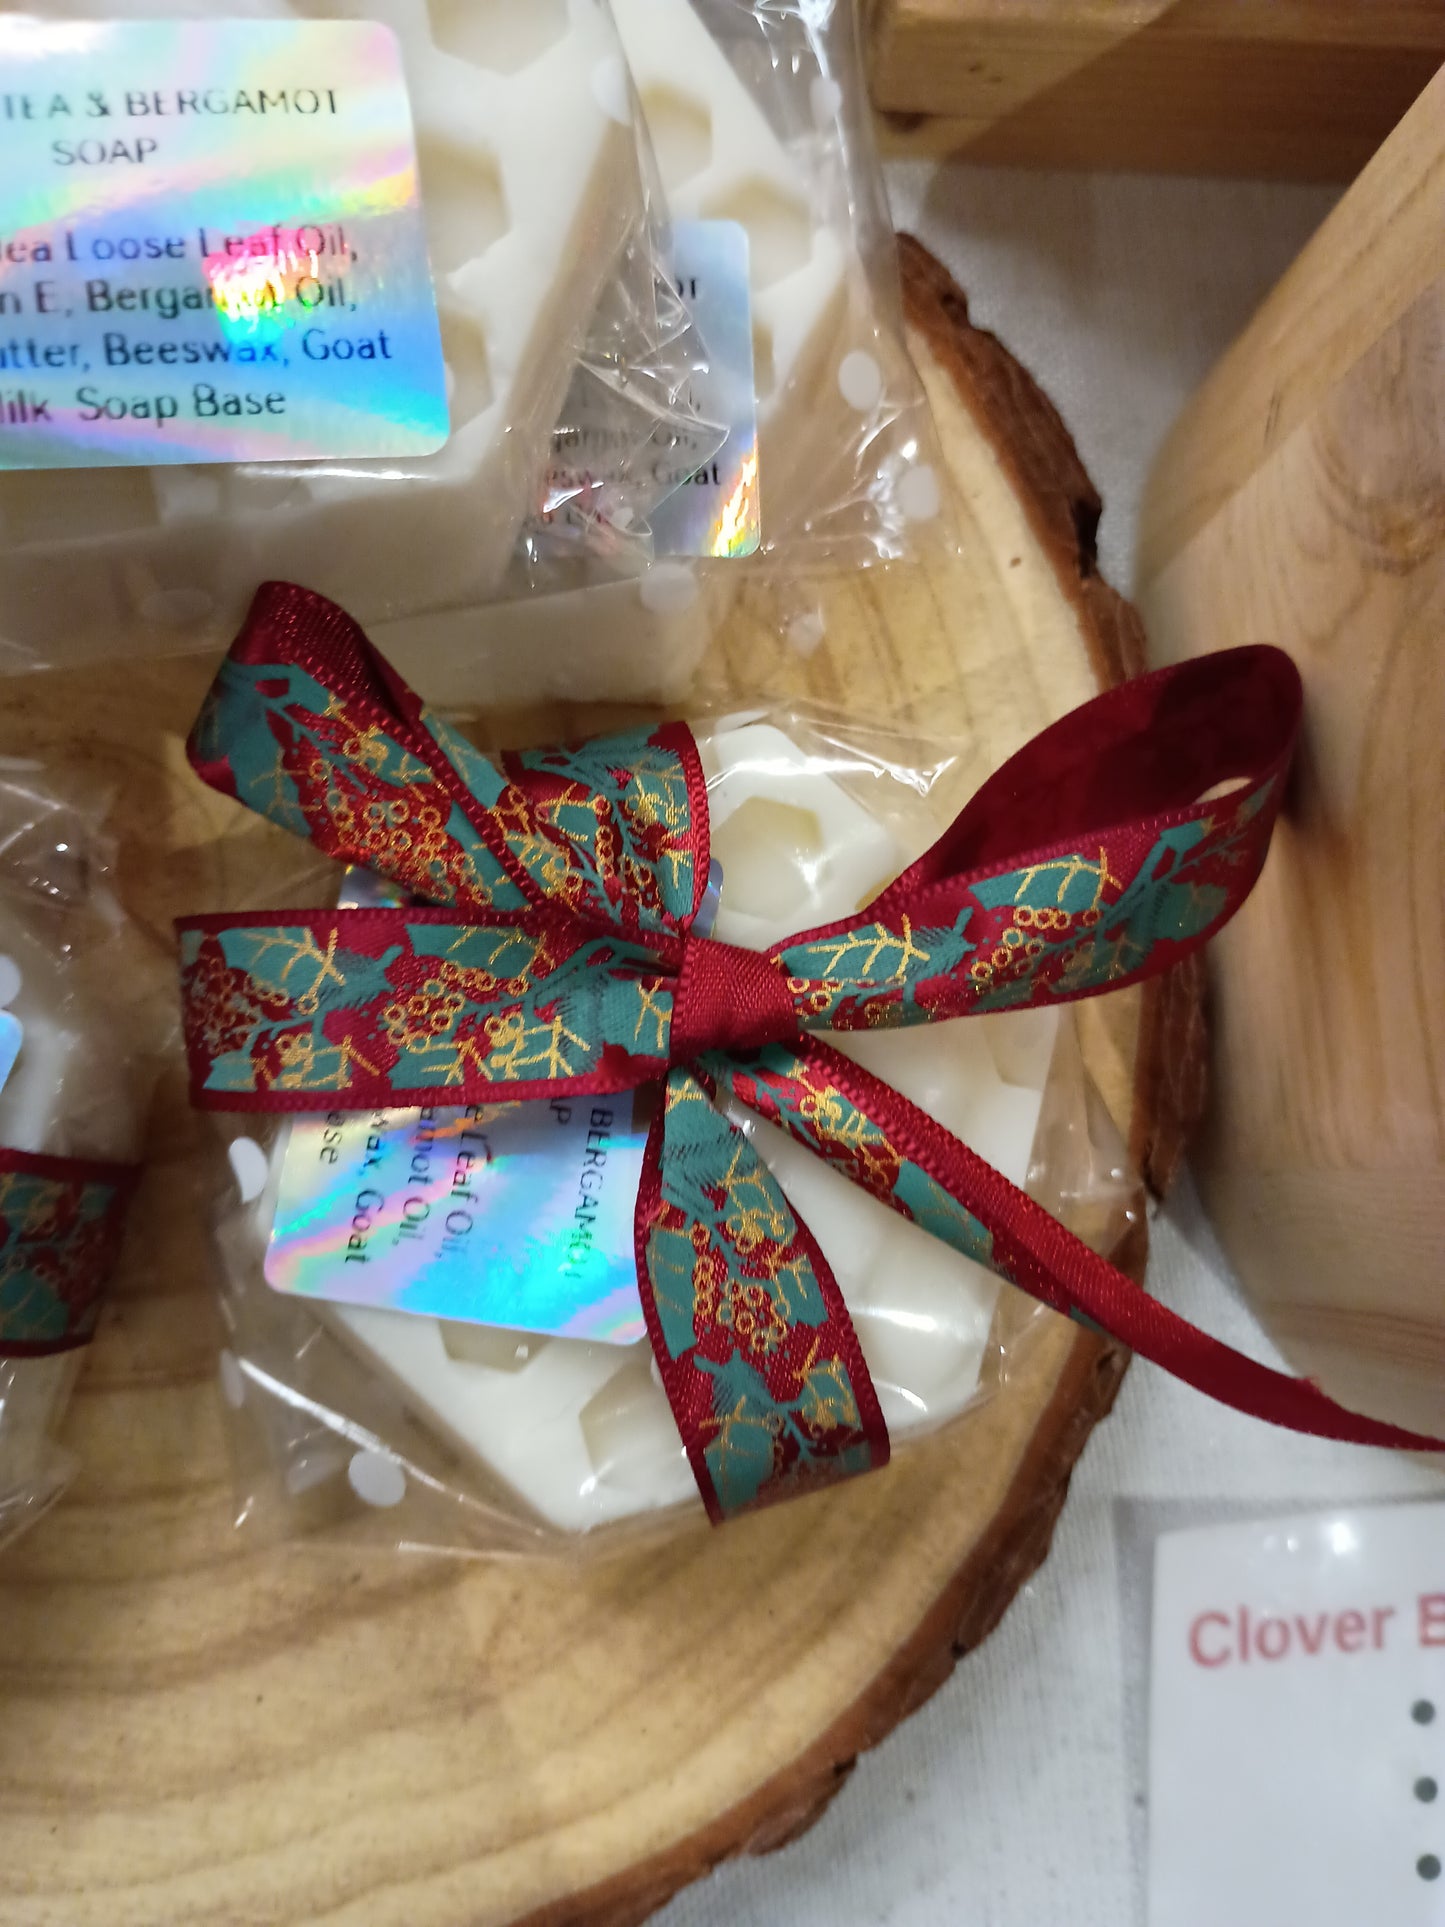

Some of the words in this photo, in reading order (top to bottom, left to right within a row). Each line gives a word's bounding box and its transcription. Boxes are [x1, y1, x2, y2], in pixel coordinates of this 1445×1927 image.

[86, 91, 111, 118] &
[125, 88, 338, 117] BERGAMOT
[51, 137, 157, 166] SOAP
[0, 235, 51, 263] ea
[66, 230, 185, 261] Loose
[199, 222, 281, 258] Leaf
[296, 224, 357, 262] Oil,
[86, 278, 284, 320] Bergao
[296, 275, 356, 312] Oil,
[103, 330, 290, 367] Beeswax,
[302, 329, 393, 361] Goat
[0, 388, 52, 425] ilk
[76, 385, 178, 429] Soap
[193, 384, 286, 418] Base
[564, 1107, 614, 1278] BERGAMOT
[344, 1187, 385, 1264] Goat
[392, 1196, 431, 1247] Oil,
[1188, 1603, 1397, 1669] Clover
